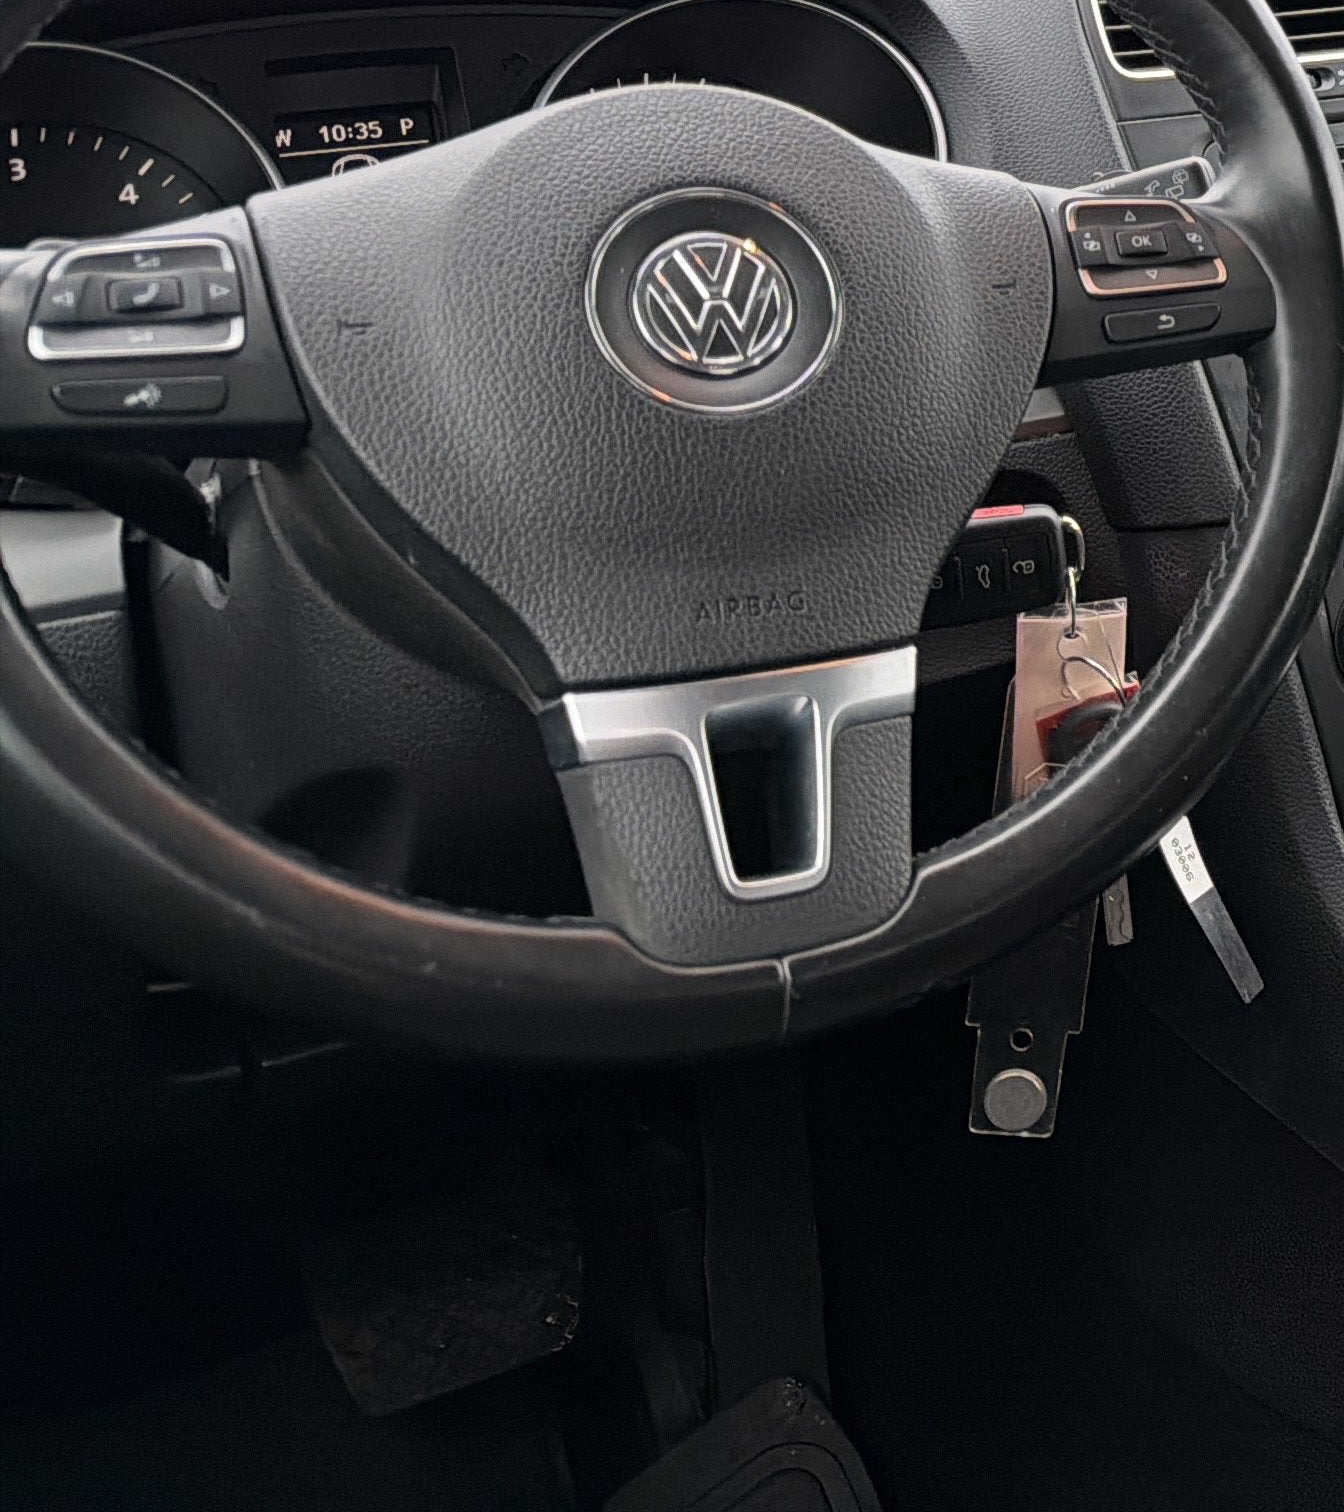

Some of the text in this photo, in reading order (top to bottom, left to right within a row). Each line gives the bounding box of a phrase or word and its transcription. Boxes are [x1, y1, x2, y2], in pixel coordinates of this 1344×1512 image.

[318, 120, 383, 143] 10:35
[399, 117, 414, 136] P
[8, 158, 27, 182] 3
[118, 184, 140, 205] 4
[1131, 235, 1153, 248] OK
[696, 590, 808, 622] AIRBAG
